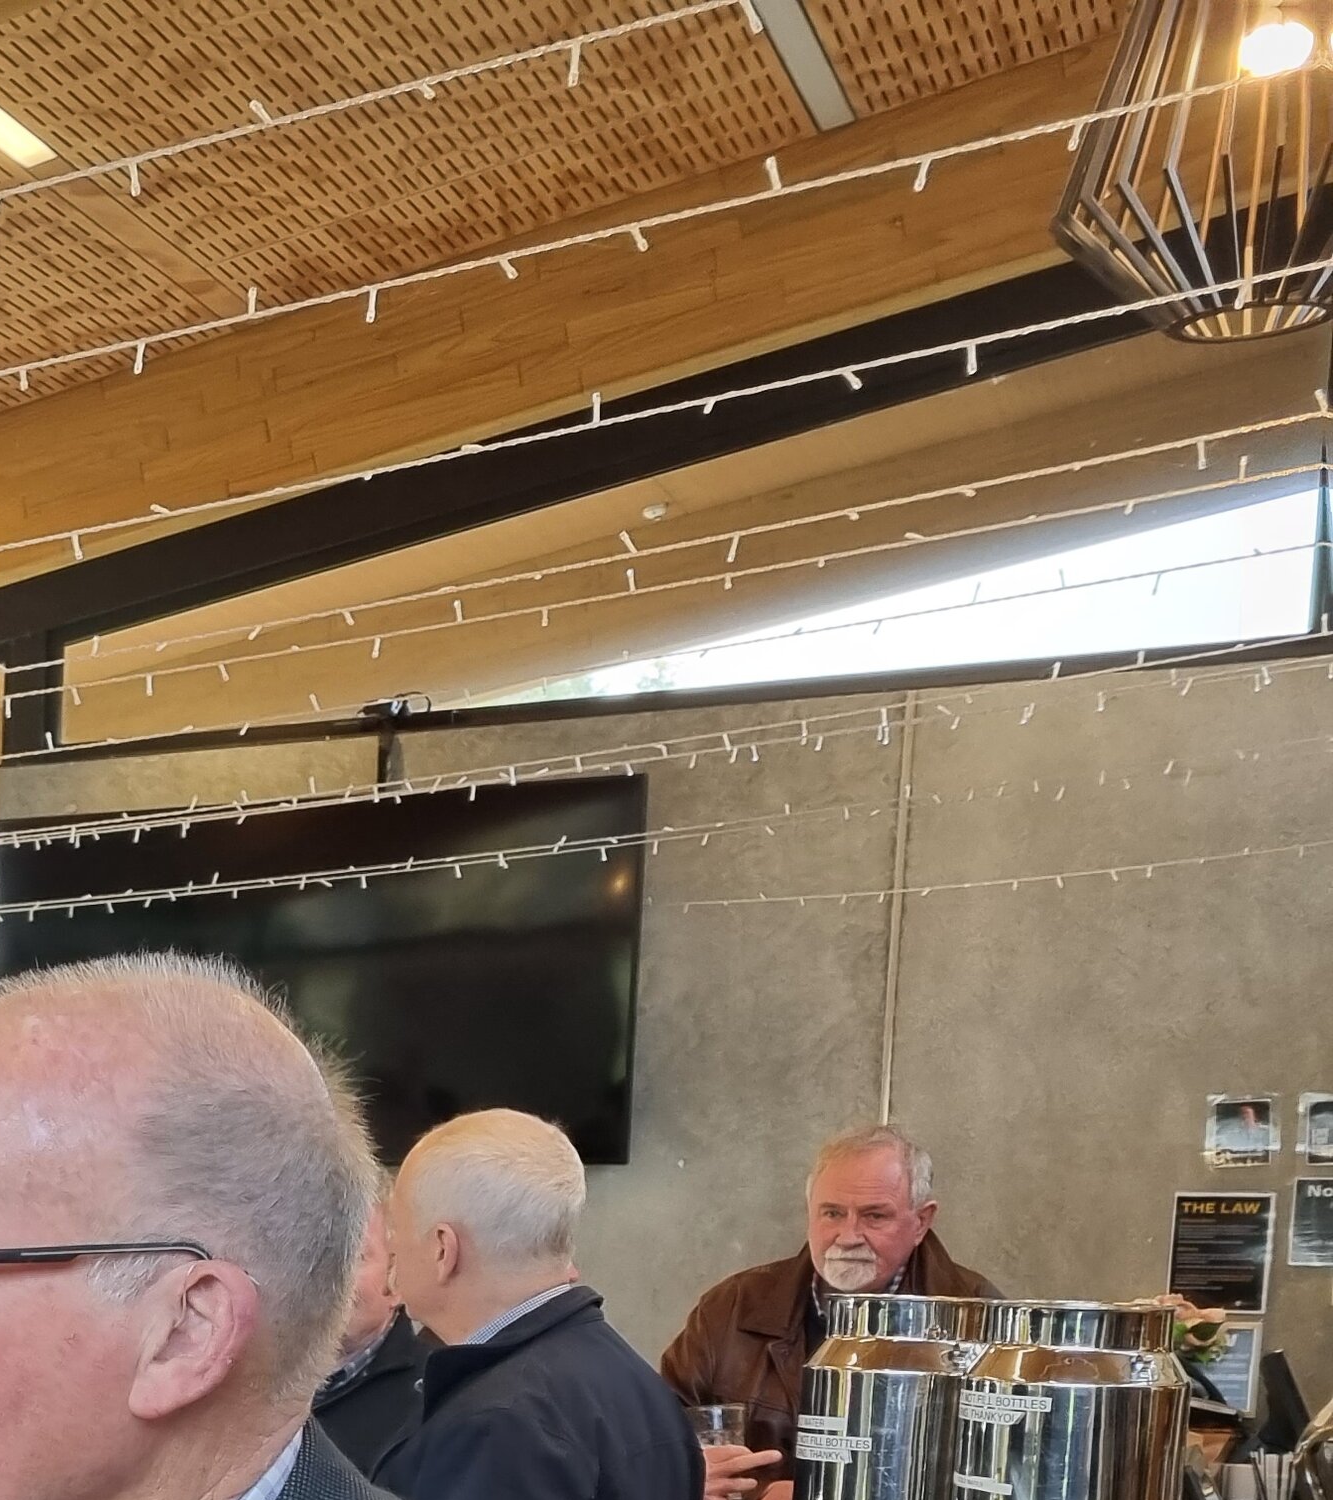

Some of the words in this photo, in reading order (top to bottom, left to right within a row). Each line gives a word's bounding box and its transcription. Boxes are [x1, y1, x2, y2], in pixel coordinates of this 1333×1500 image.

[1181, 1201, 1216, 1214] THE
[1220, 1202, 1261, 1214] LAW
[995, 1396, 1047, 1410] BOTTLES
[825, 1437, 870, 1449] BOTTLES
